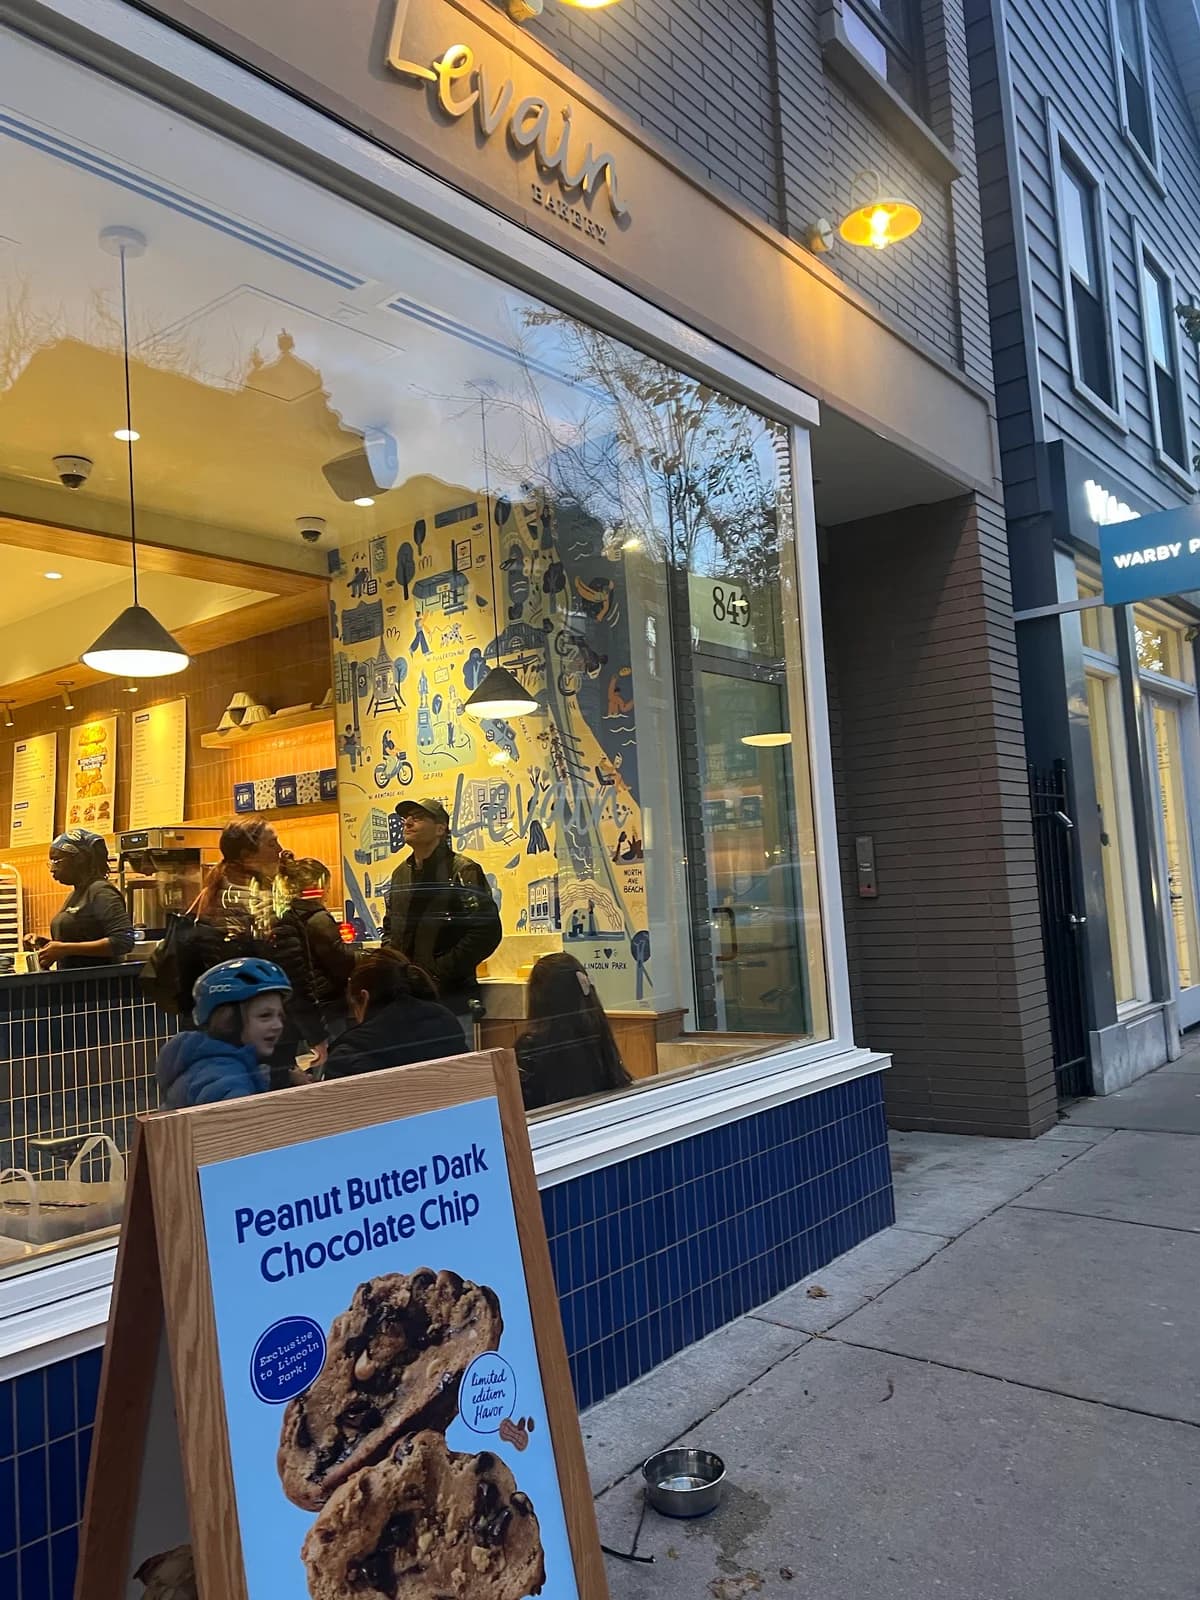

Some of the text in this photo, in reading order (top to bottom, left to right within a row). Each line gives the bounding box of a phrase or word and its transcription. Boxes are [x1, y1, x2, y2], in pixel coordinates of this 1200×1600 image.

[388, 0, 628, 217] Levain
[531, 183, 608, 245] BAKERY
[1113, 542, 1182, 569] WARBY
[712, 586, 751, 628] 849
[623, 868, 643, 877] NORTH
[623, 886, 644, 894] BEACH
[584, 961, 627, 970] LINCOLN PARK
[235, 1143, 489, 1244] Peanut Butter Dark
[260, 1190, 480, 1283] Chocolate Chip
[259, 1331, 313, 1367] Exclusive
[260, 1342, 320, 1380] to Lincoln
[278, 1361, 307, 1386] Park!
[471, 1368, 507, 1387] limited
[472, 1387, 506, 1404] edition
[474, 1405, 504, 1426] flavor
